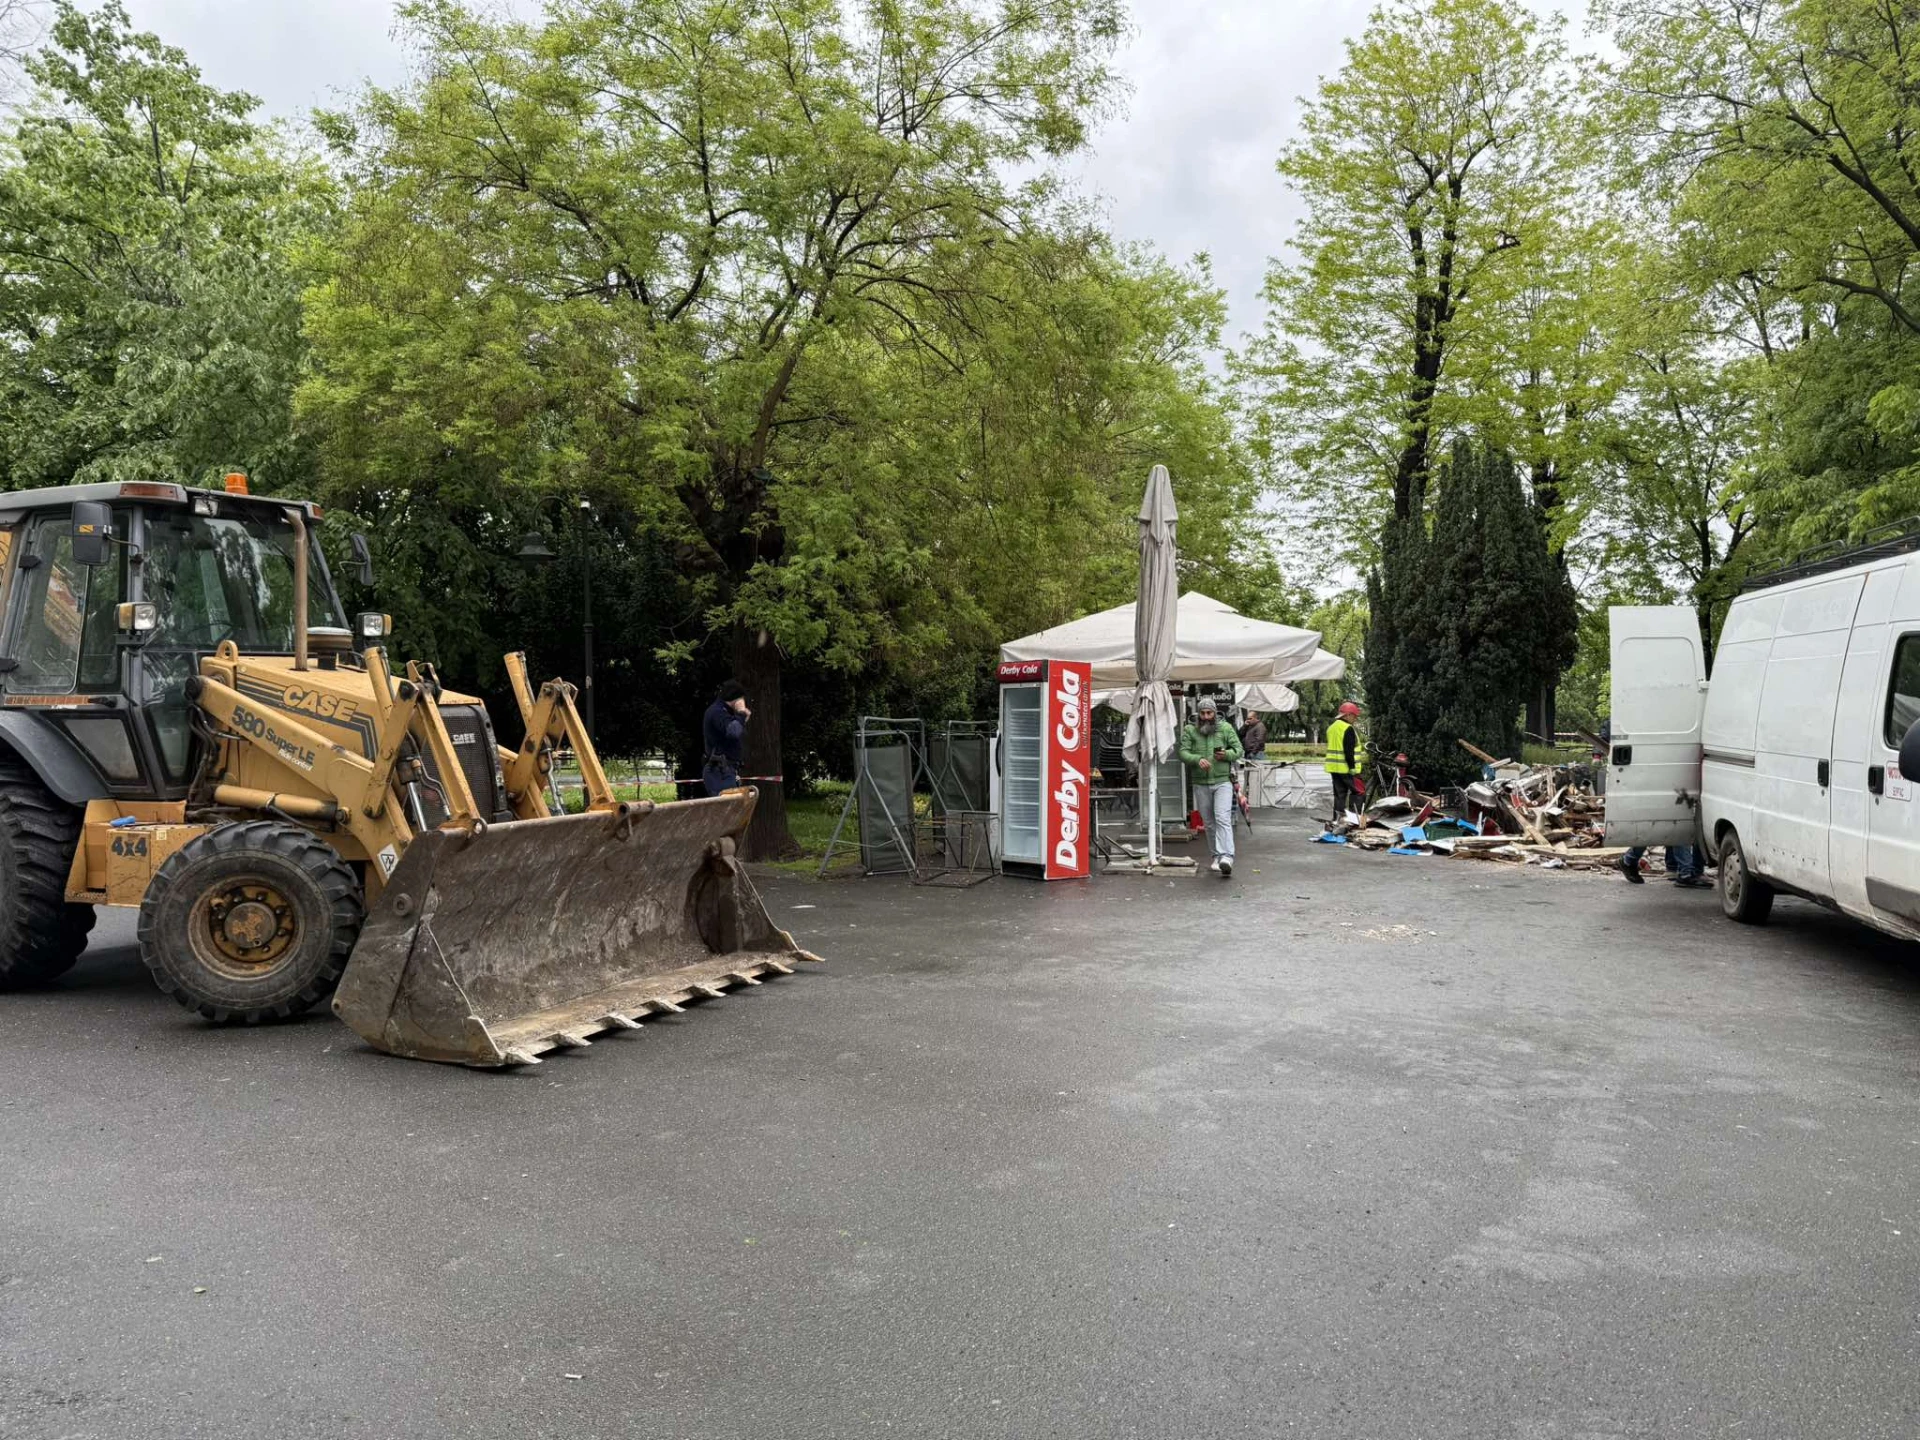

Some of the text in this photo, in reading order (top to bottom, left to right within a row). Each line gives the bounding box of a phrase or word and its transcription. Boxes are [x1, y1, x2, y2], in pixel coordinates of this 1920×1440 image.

[1000, 664, 1038, 677] Derby Cola
[1167, 683, 1182, 691] ola
[282, 684, 359, 723] CASE
[231, 704, 316, 766] 580 Super LE
[453, 733, 476, 744] CASE
[1054, 668, 1085, 871] Derby Cola
[111, 836, 148, 857] 4x4
